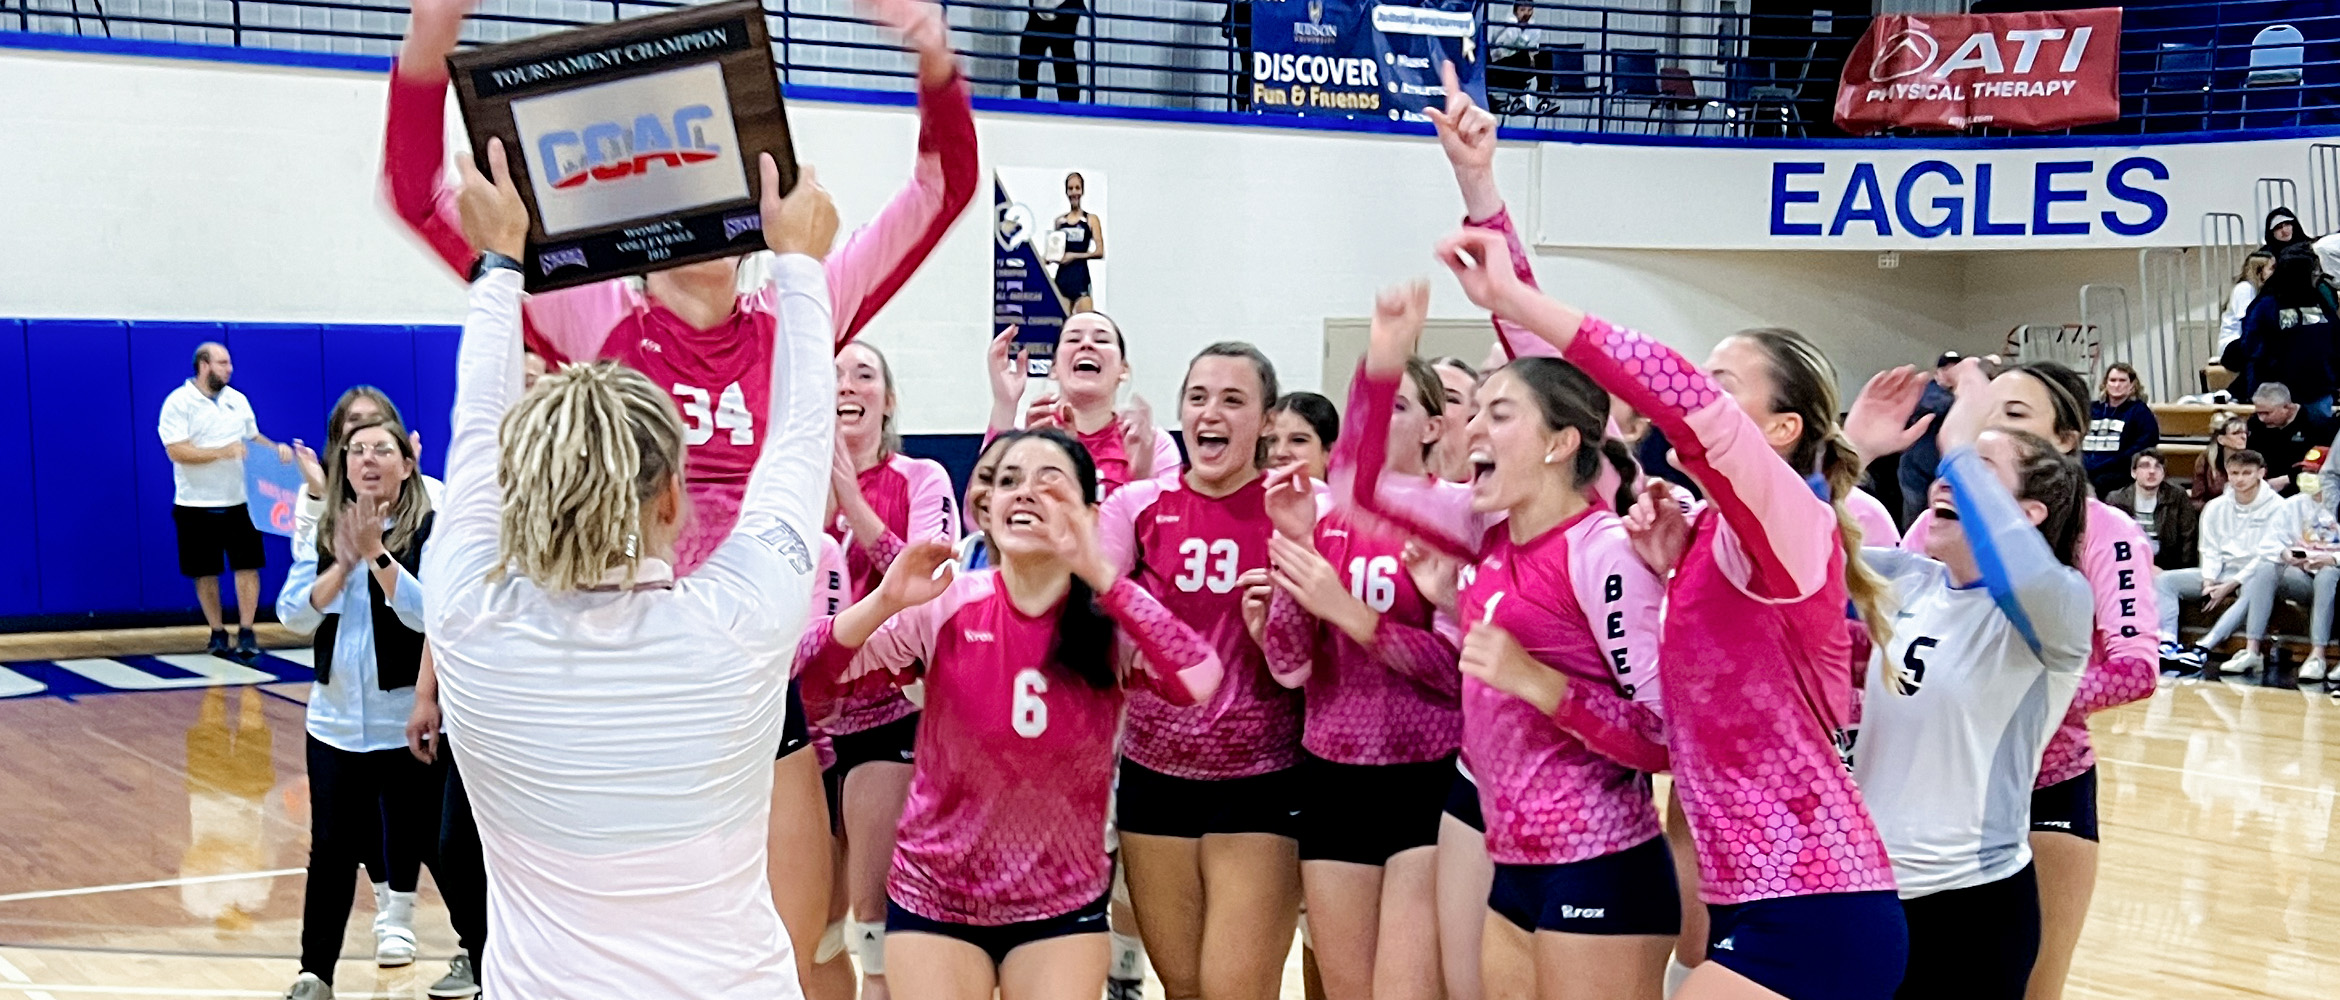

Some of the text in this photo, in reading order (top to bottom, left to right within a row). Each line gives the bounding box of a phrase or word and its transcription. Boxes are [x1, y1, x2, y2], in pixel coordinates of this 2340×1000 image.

[491, 27, 728, 88] TOURNAMENT CHAMPION
[1253, 51, 1379, 87] DISCOVER
[1930, 26, 2093, 79] ATI
[1253, 83, 1287, 105] Fun
[1291, 84, 1306, 107] &
[1310, 85, 1380, 110] Friends
[1866, 80, 2077, 103] PHYSICAL THERAPY
[1770, 156, 2170, 239] EAGLES
[672, 380, 754, 446] 34
[1175, 538, 1239, 594] 33
[1349, 555, 1397, 613] 16
[1011, 668, 1048, 738] 6
